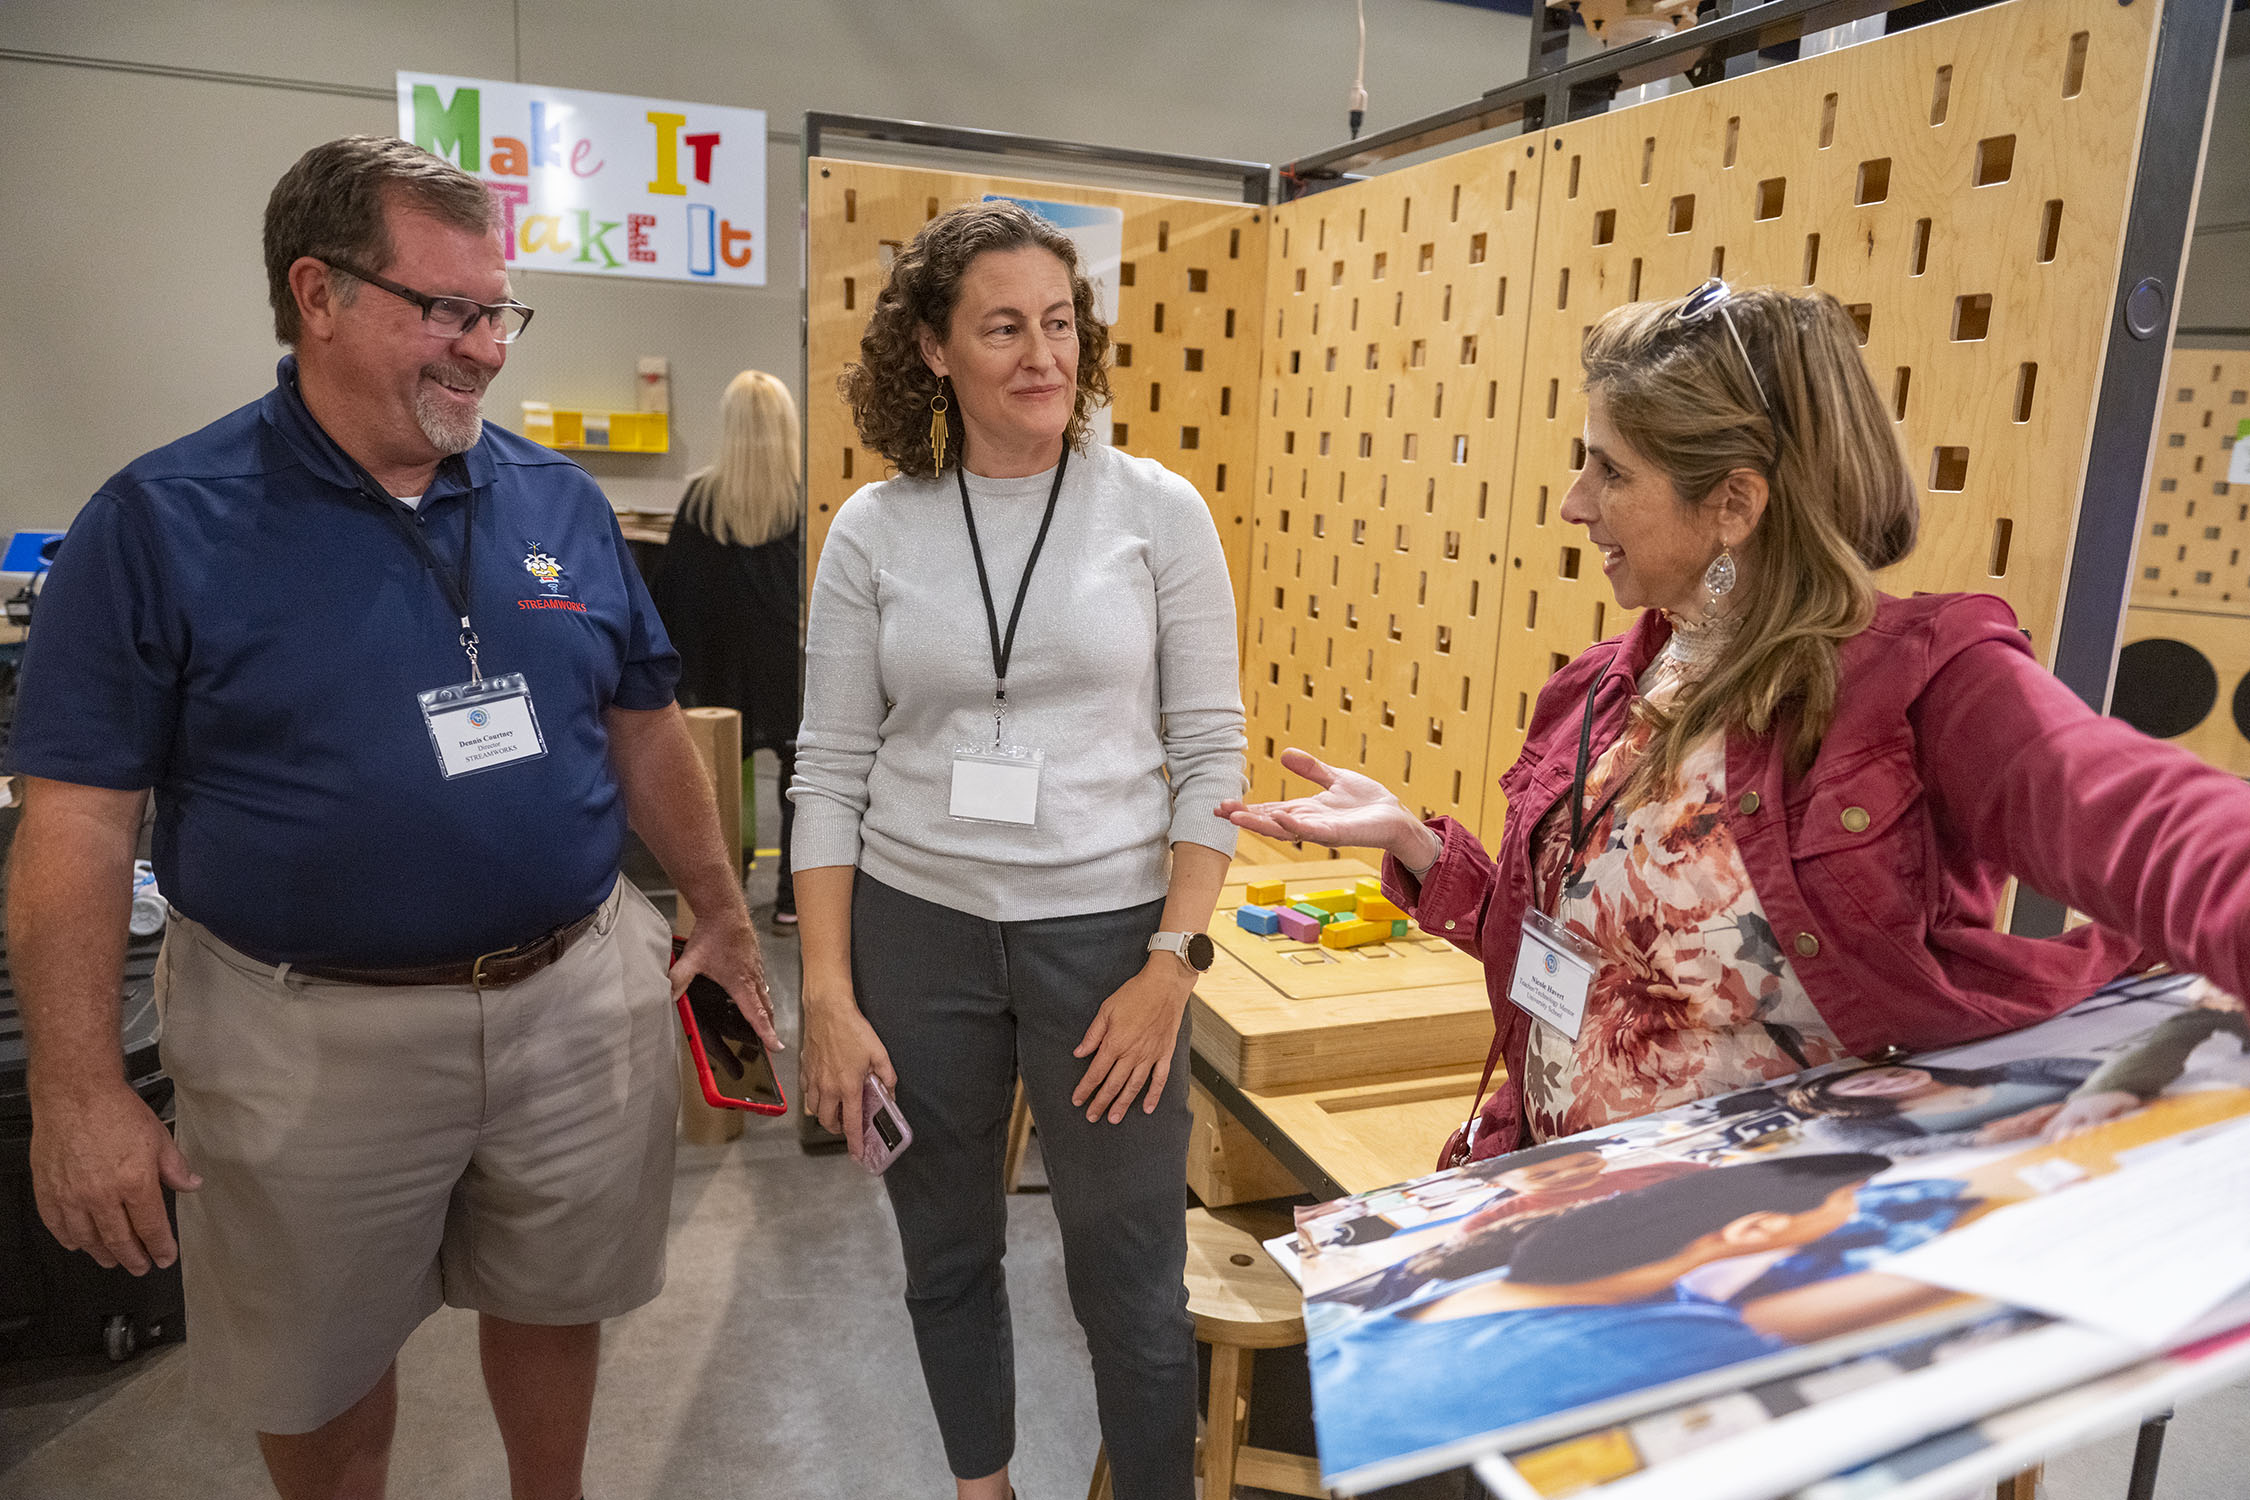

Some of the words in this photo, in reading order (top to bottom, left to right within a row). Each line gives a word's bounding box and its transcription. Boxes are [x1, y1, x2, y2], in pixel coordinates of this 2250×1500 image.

[412, 83, 604, 178] Make
[517, 599, 587, 612] STREAMWORKS
[459, 737, 483, 748] Dennis
[483, 730, 513, 741] Courtney
[478, 742, 500, 751] Director
[465, 745, 518, 762] STREAMWORKS
[1531, 976, 1547, 990] Nicole
[1526, 992, 1547, 1010] University
[1548, 1005, 1562, 1018] School
